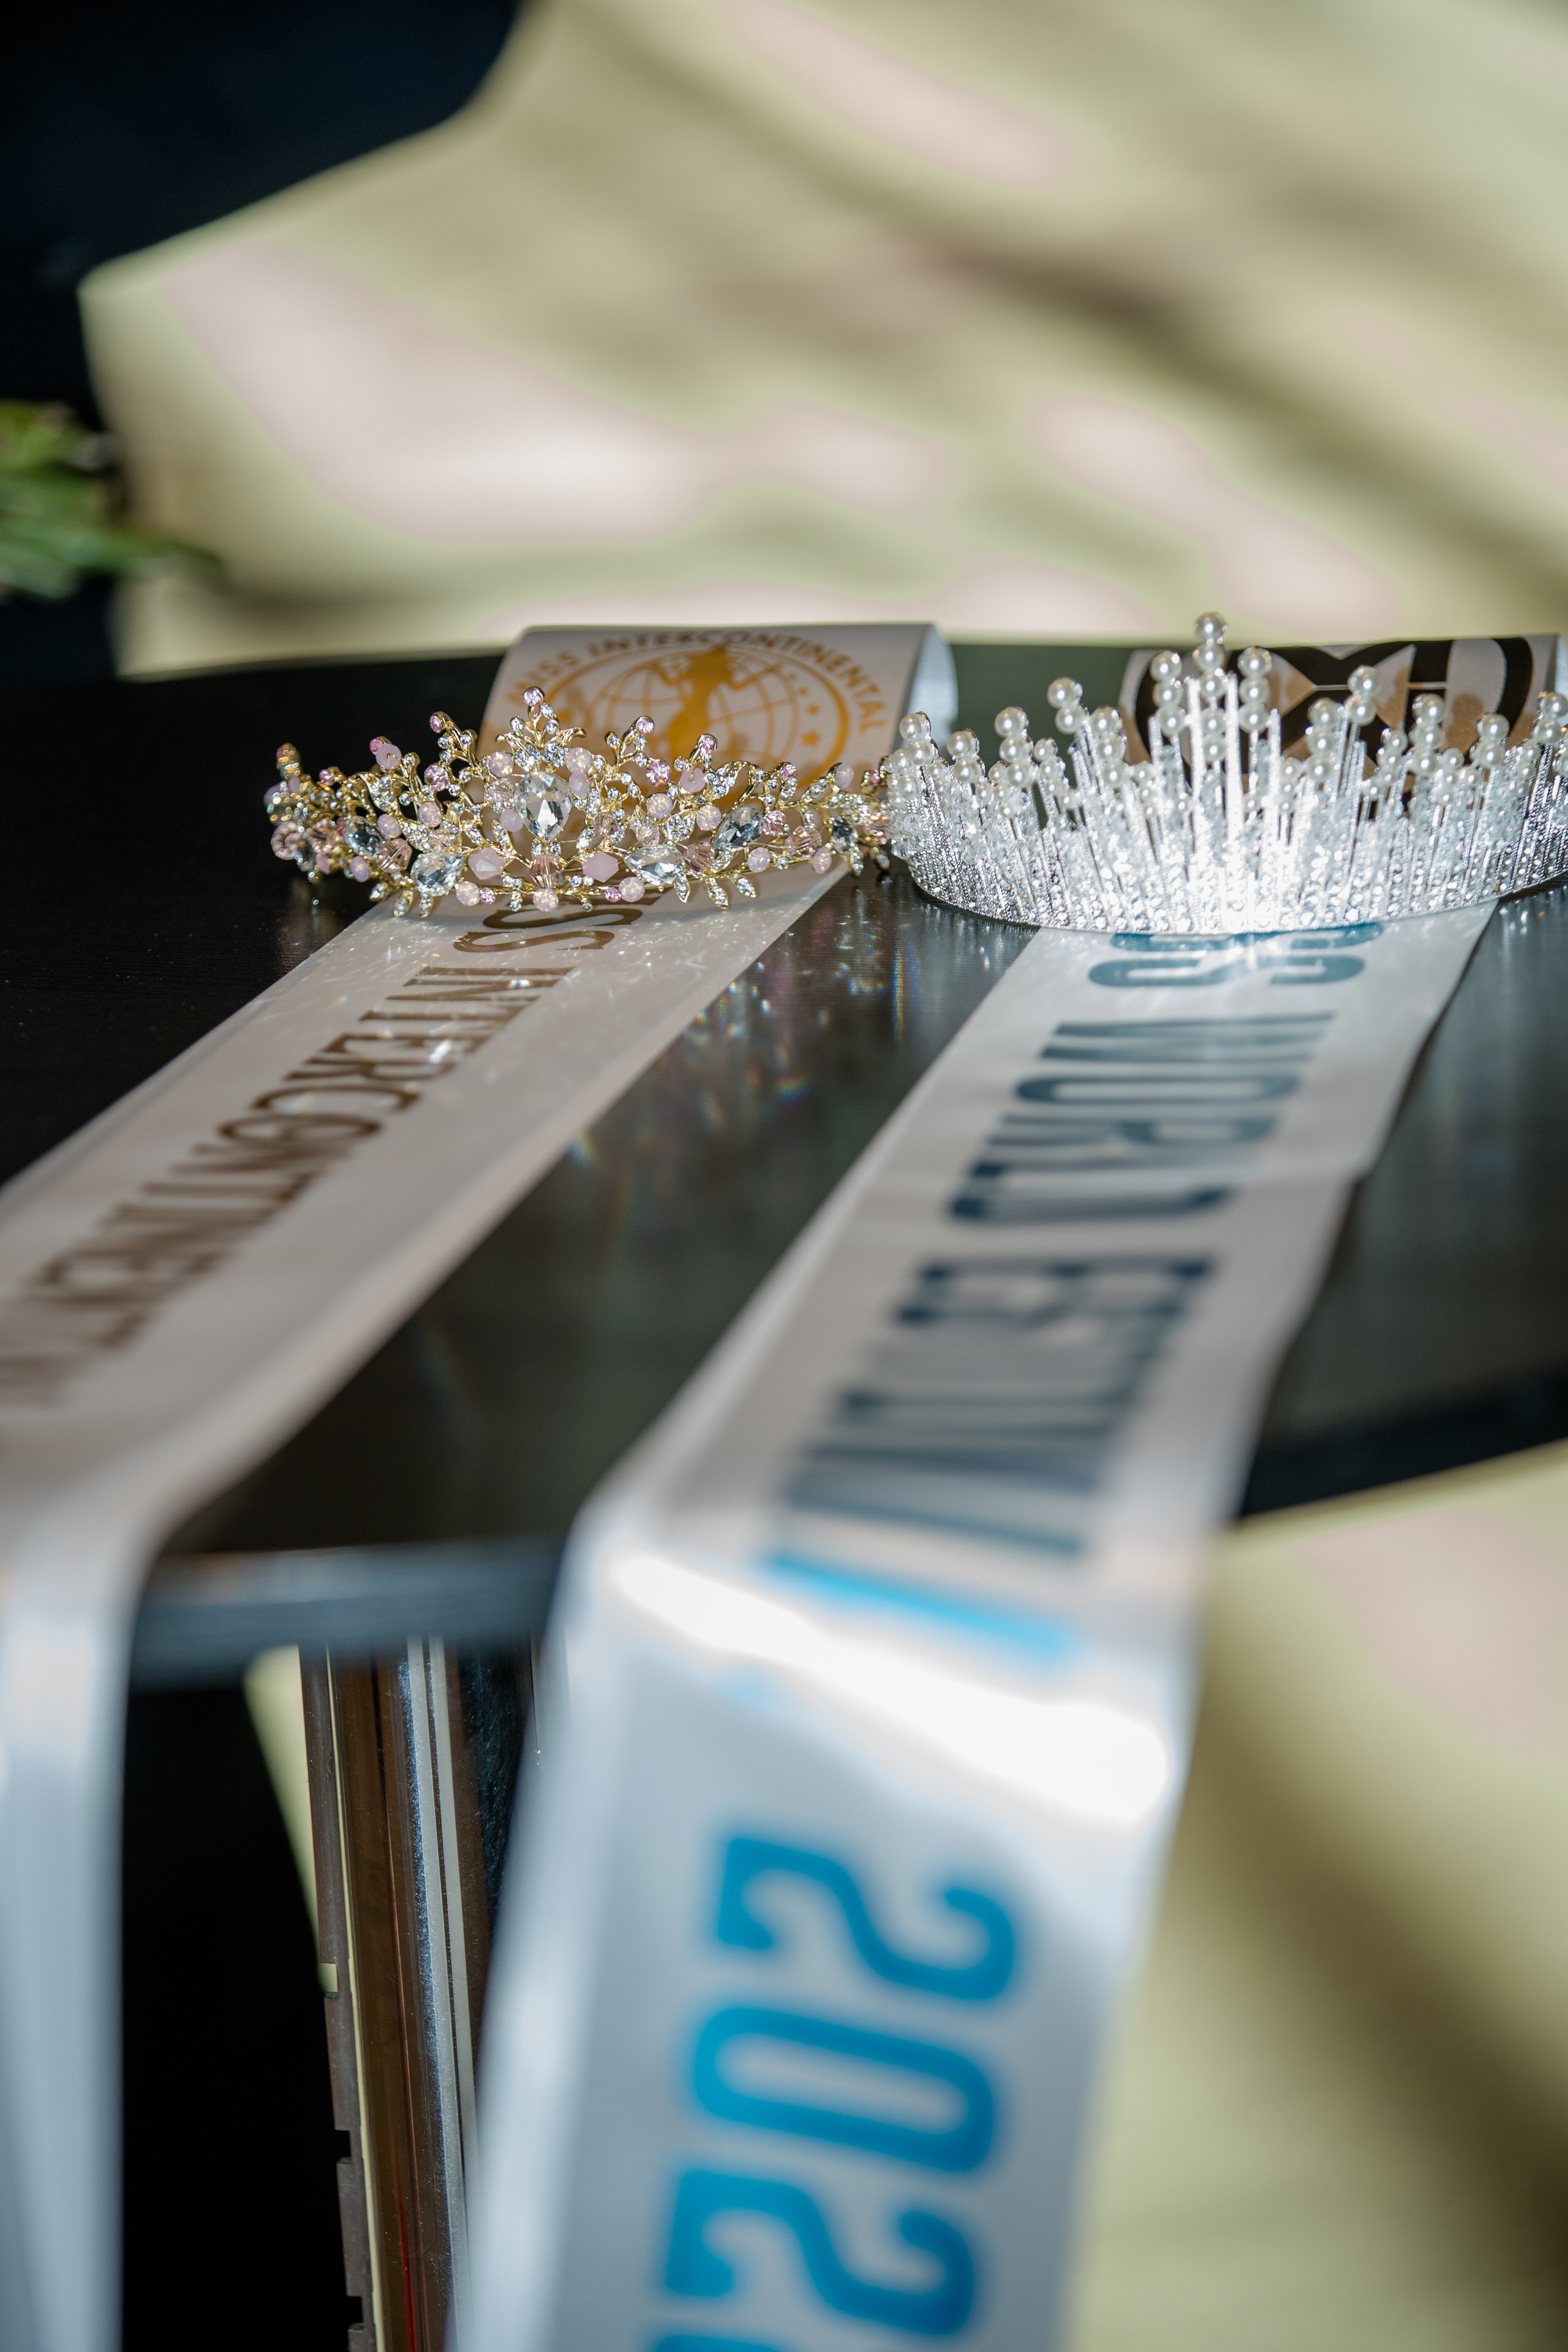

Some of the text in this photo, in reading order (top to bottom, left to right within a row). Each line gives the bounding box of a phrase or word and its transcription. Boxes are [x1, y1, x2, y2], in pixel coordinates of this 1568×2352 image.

[589, 628, 886, 734] INTERCONTINENTAL
[943, 1011, 1336, 1224] WORLD
[652, 1834, 1016, 2352] 202
